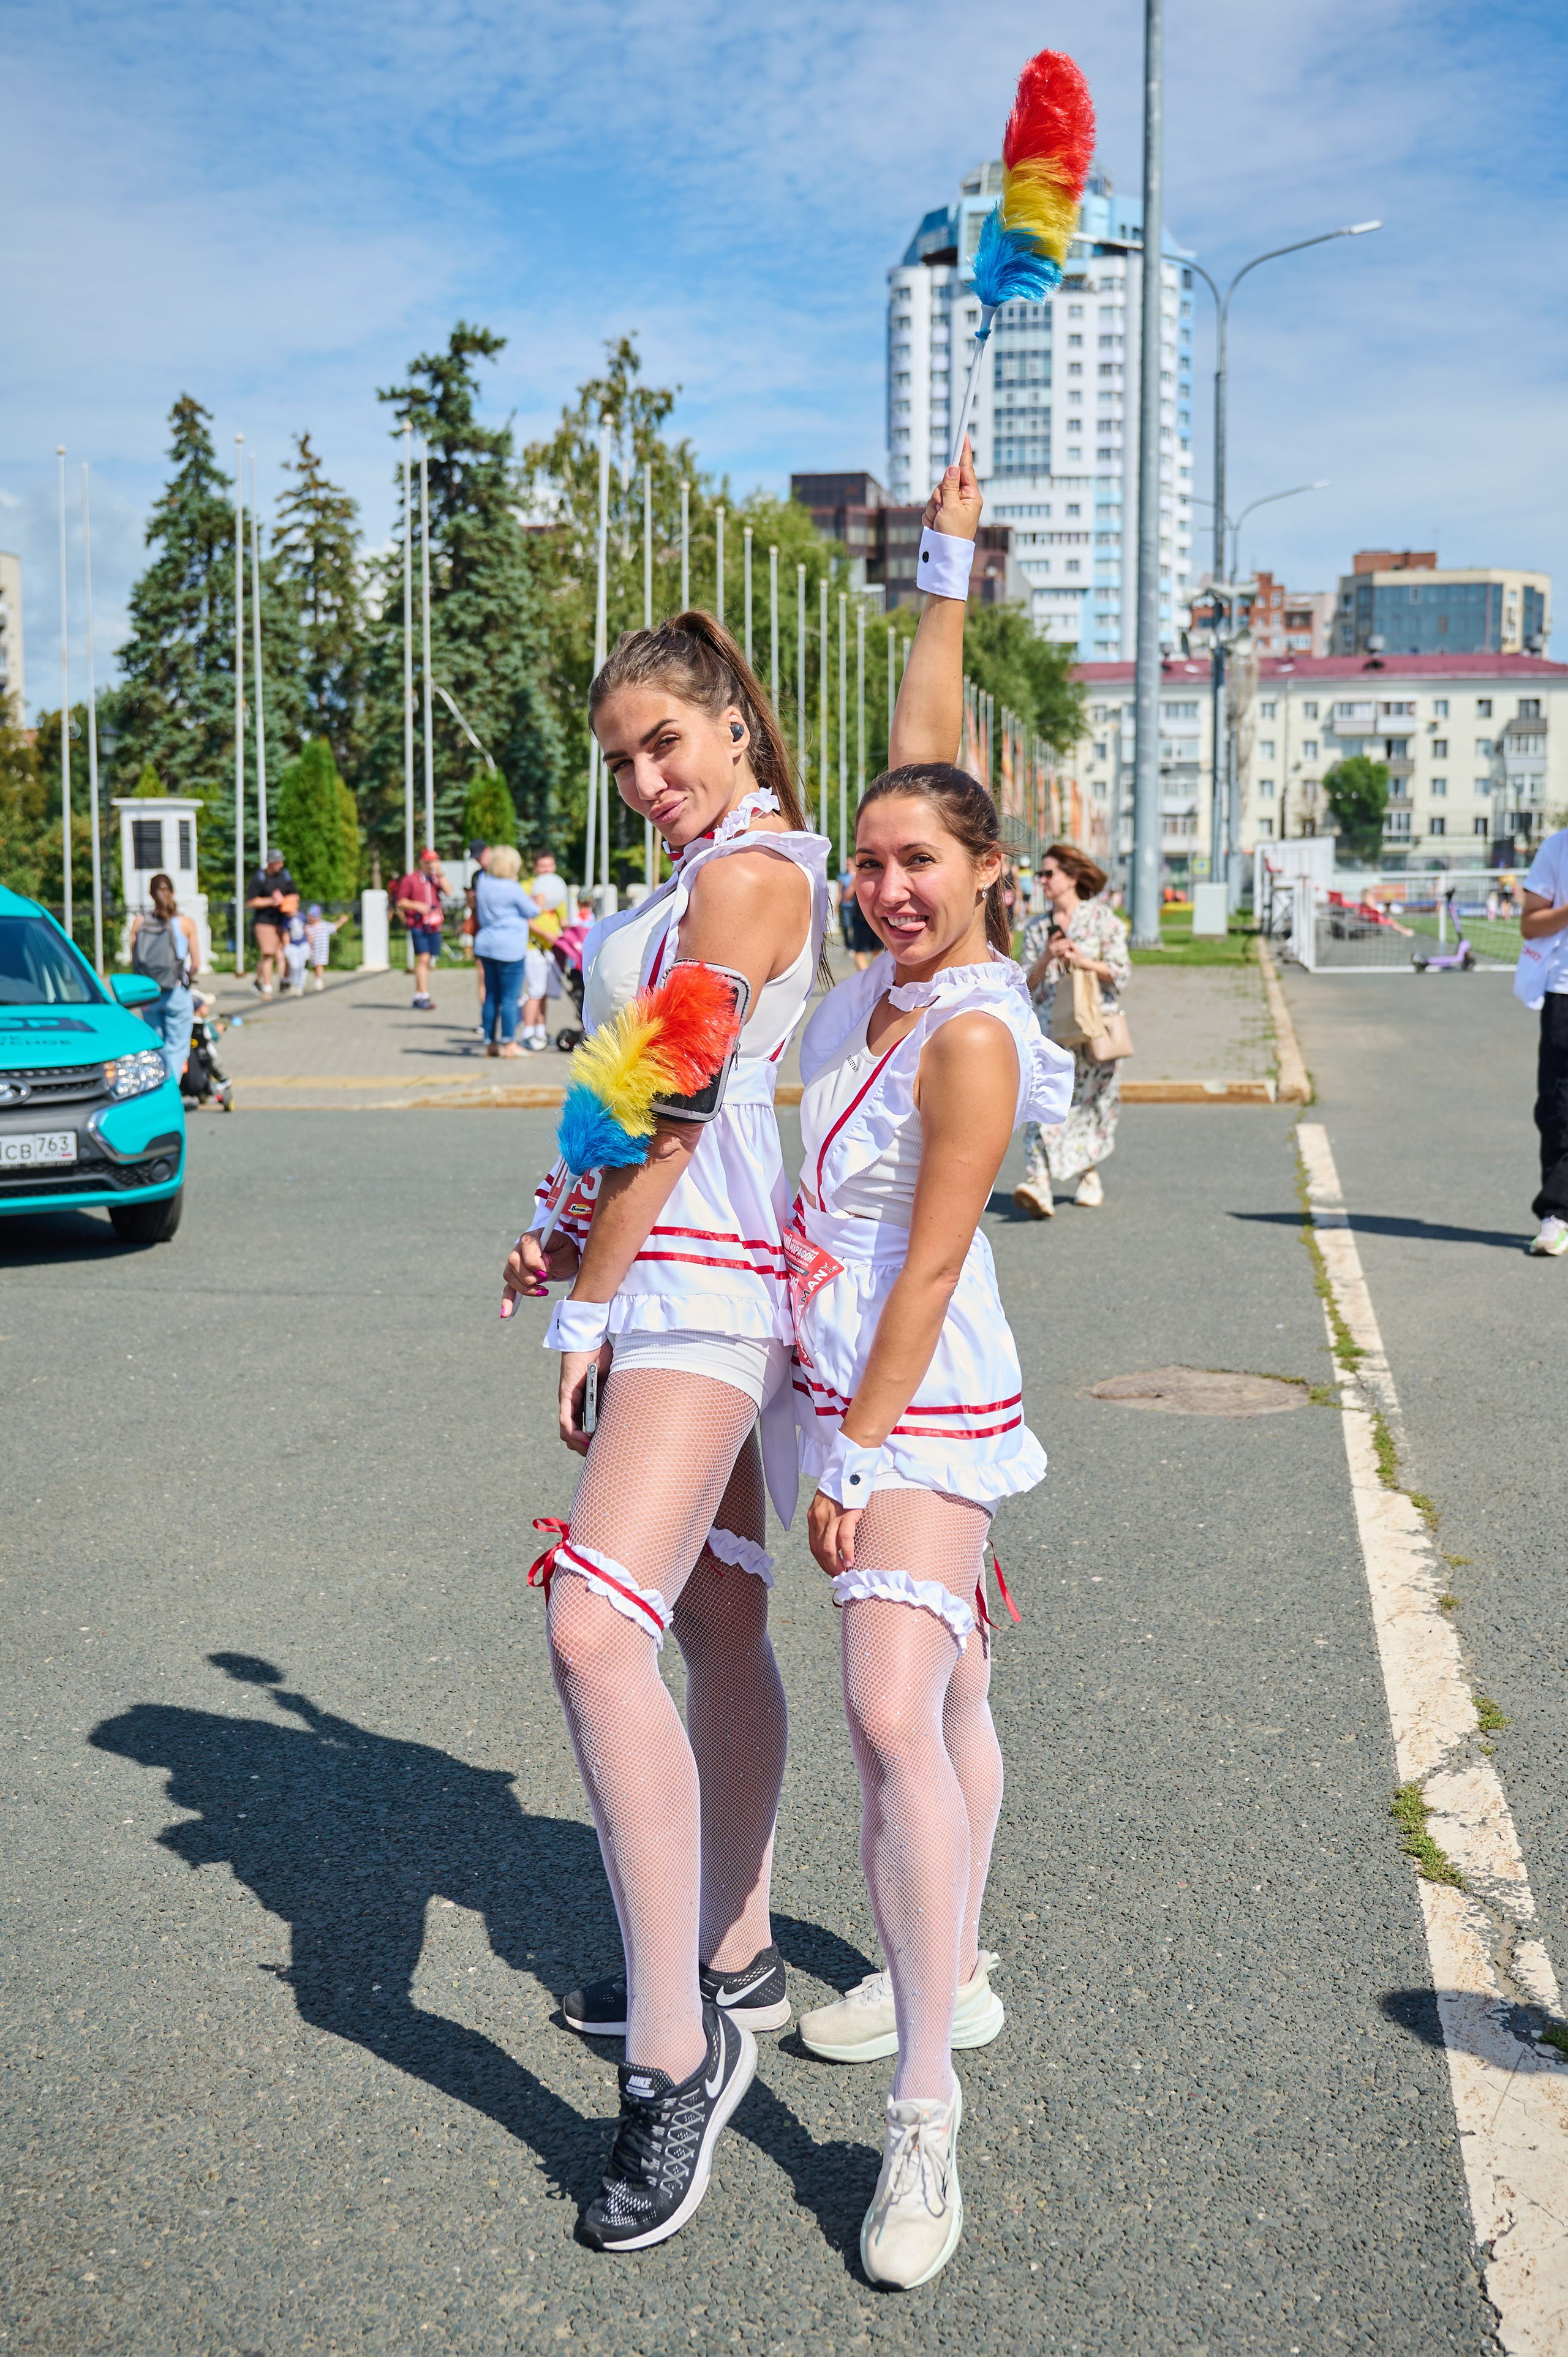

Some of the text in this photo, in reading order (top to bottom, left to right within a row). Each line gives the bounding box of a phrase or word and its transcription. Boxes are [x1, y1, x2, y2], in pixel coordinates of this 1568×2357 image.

[37, 1136, 69, 1152] 763
[790, 1242, 816, 1264] МАРАФОН
[628, 2075, 652, 2089] NIKE
